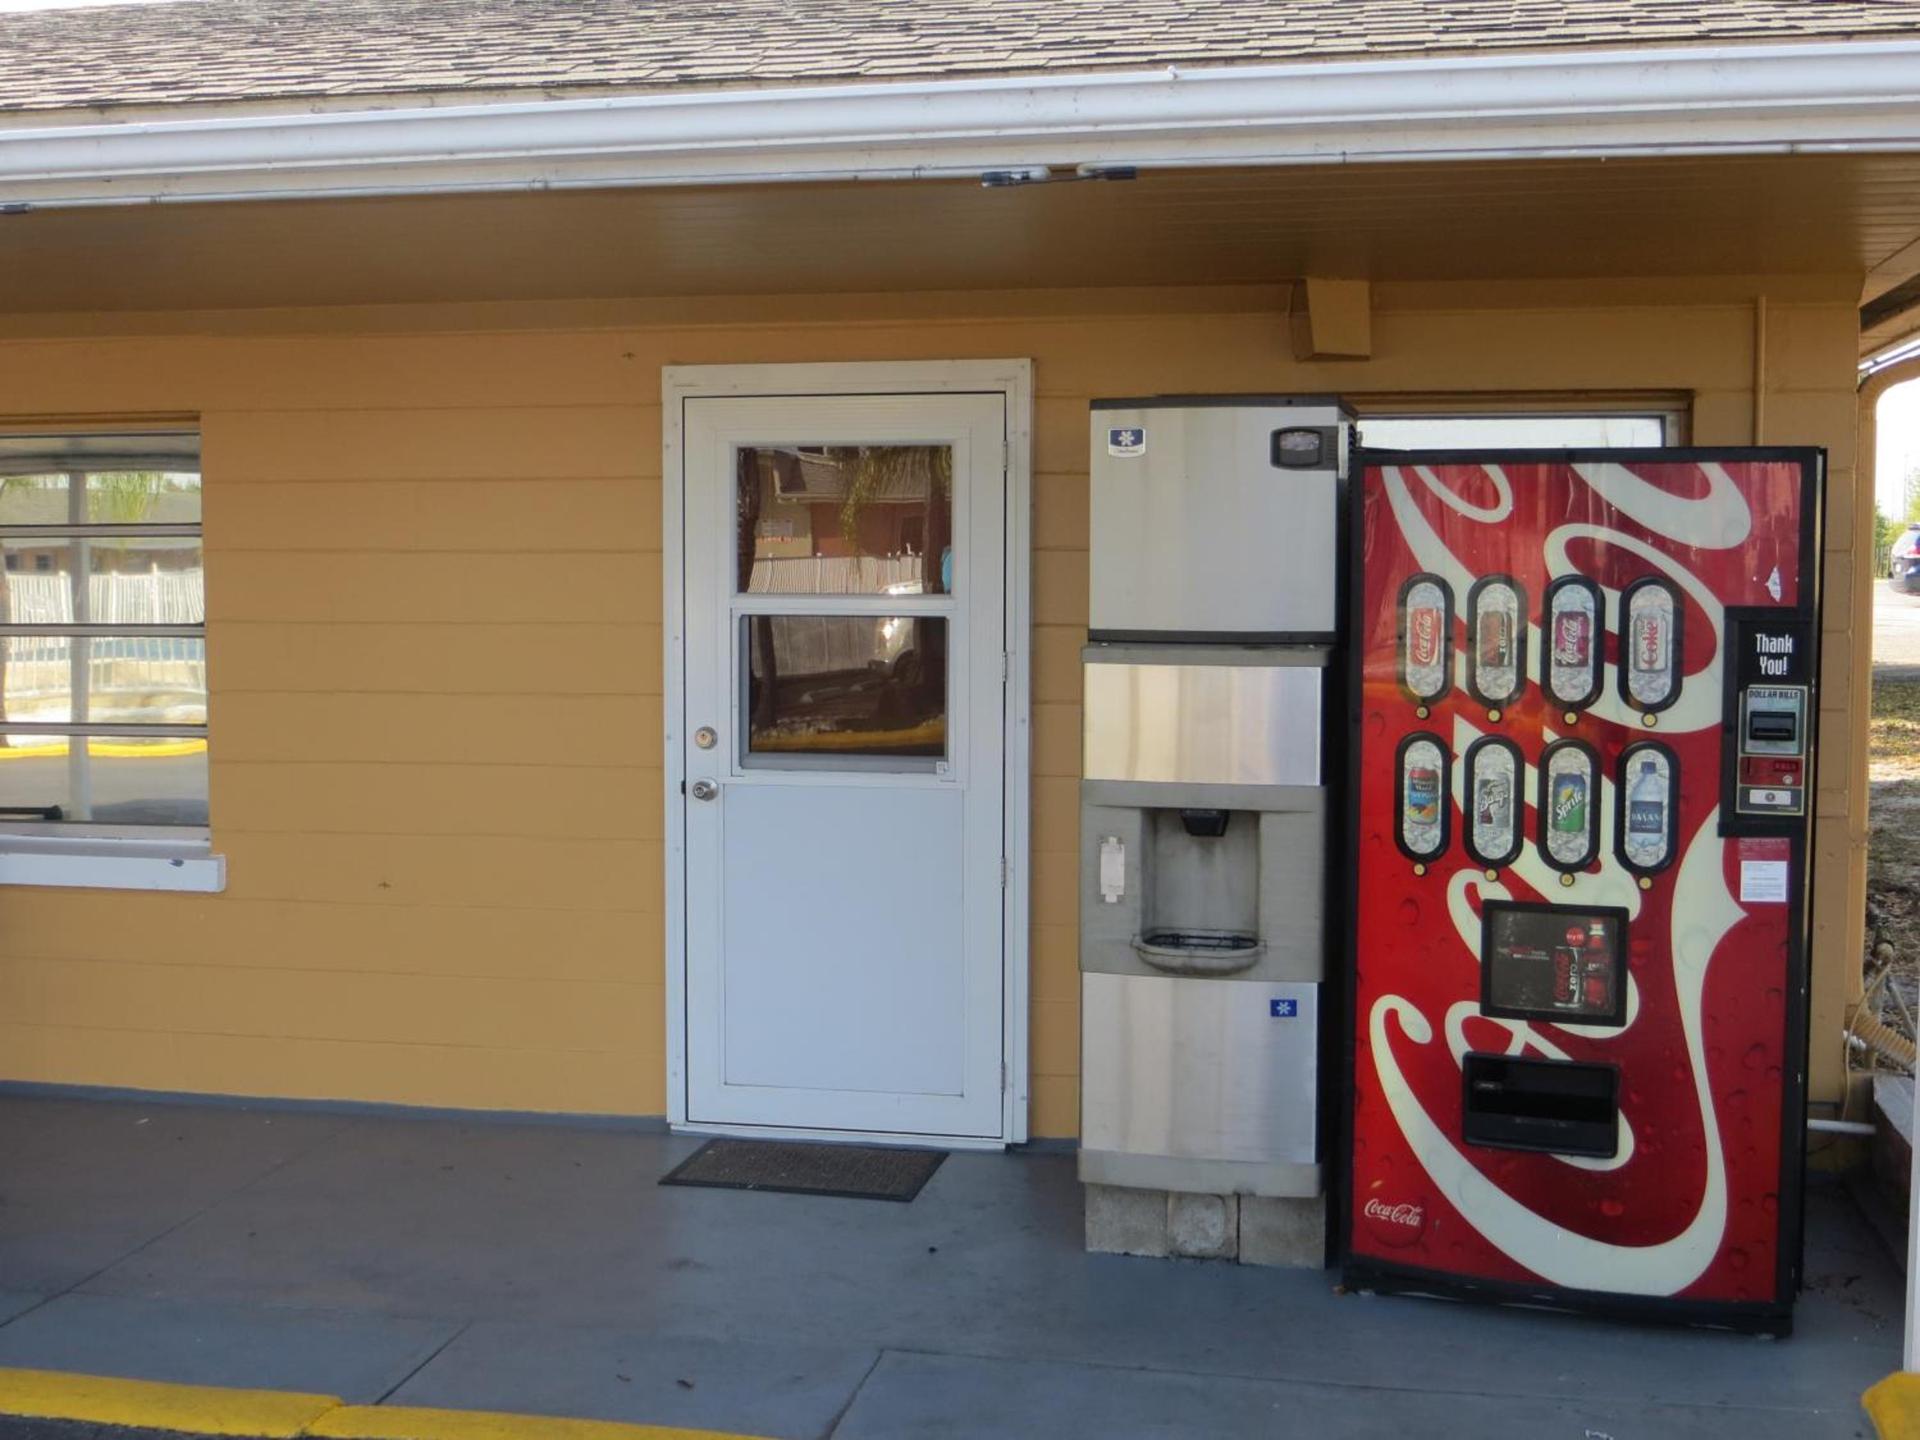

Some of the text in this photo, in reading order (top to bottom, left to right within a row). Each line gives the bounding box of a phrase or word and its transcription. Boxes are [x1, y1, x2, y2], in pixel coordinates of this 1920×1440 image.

[1754, 633, 1793, 654] Thank
[1759, 655, 1788, 676] You!
[1555, 790, 1584, 821] Sprite
[1569, 963, 1578, 991] zero
